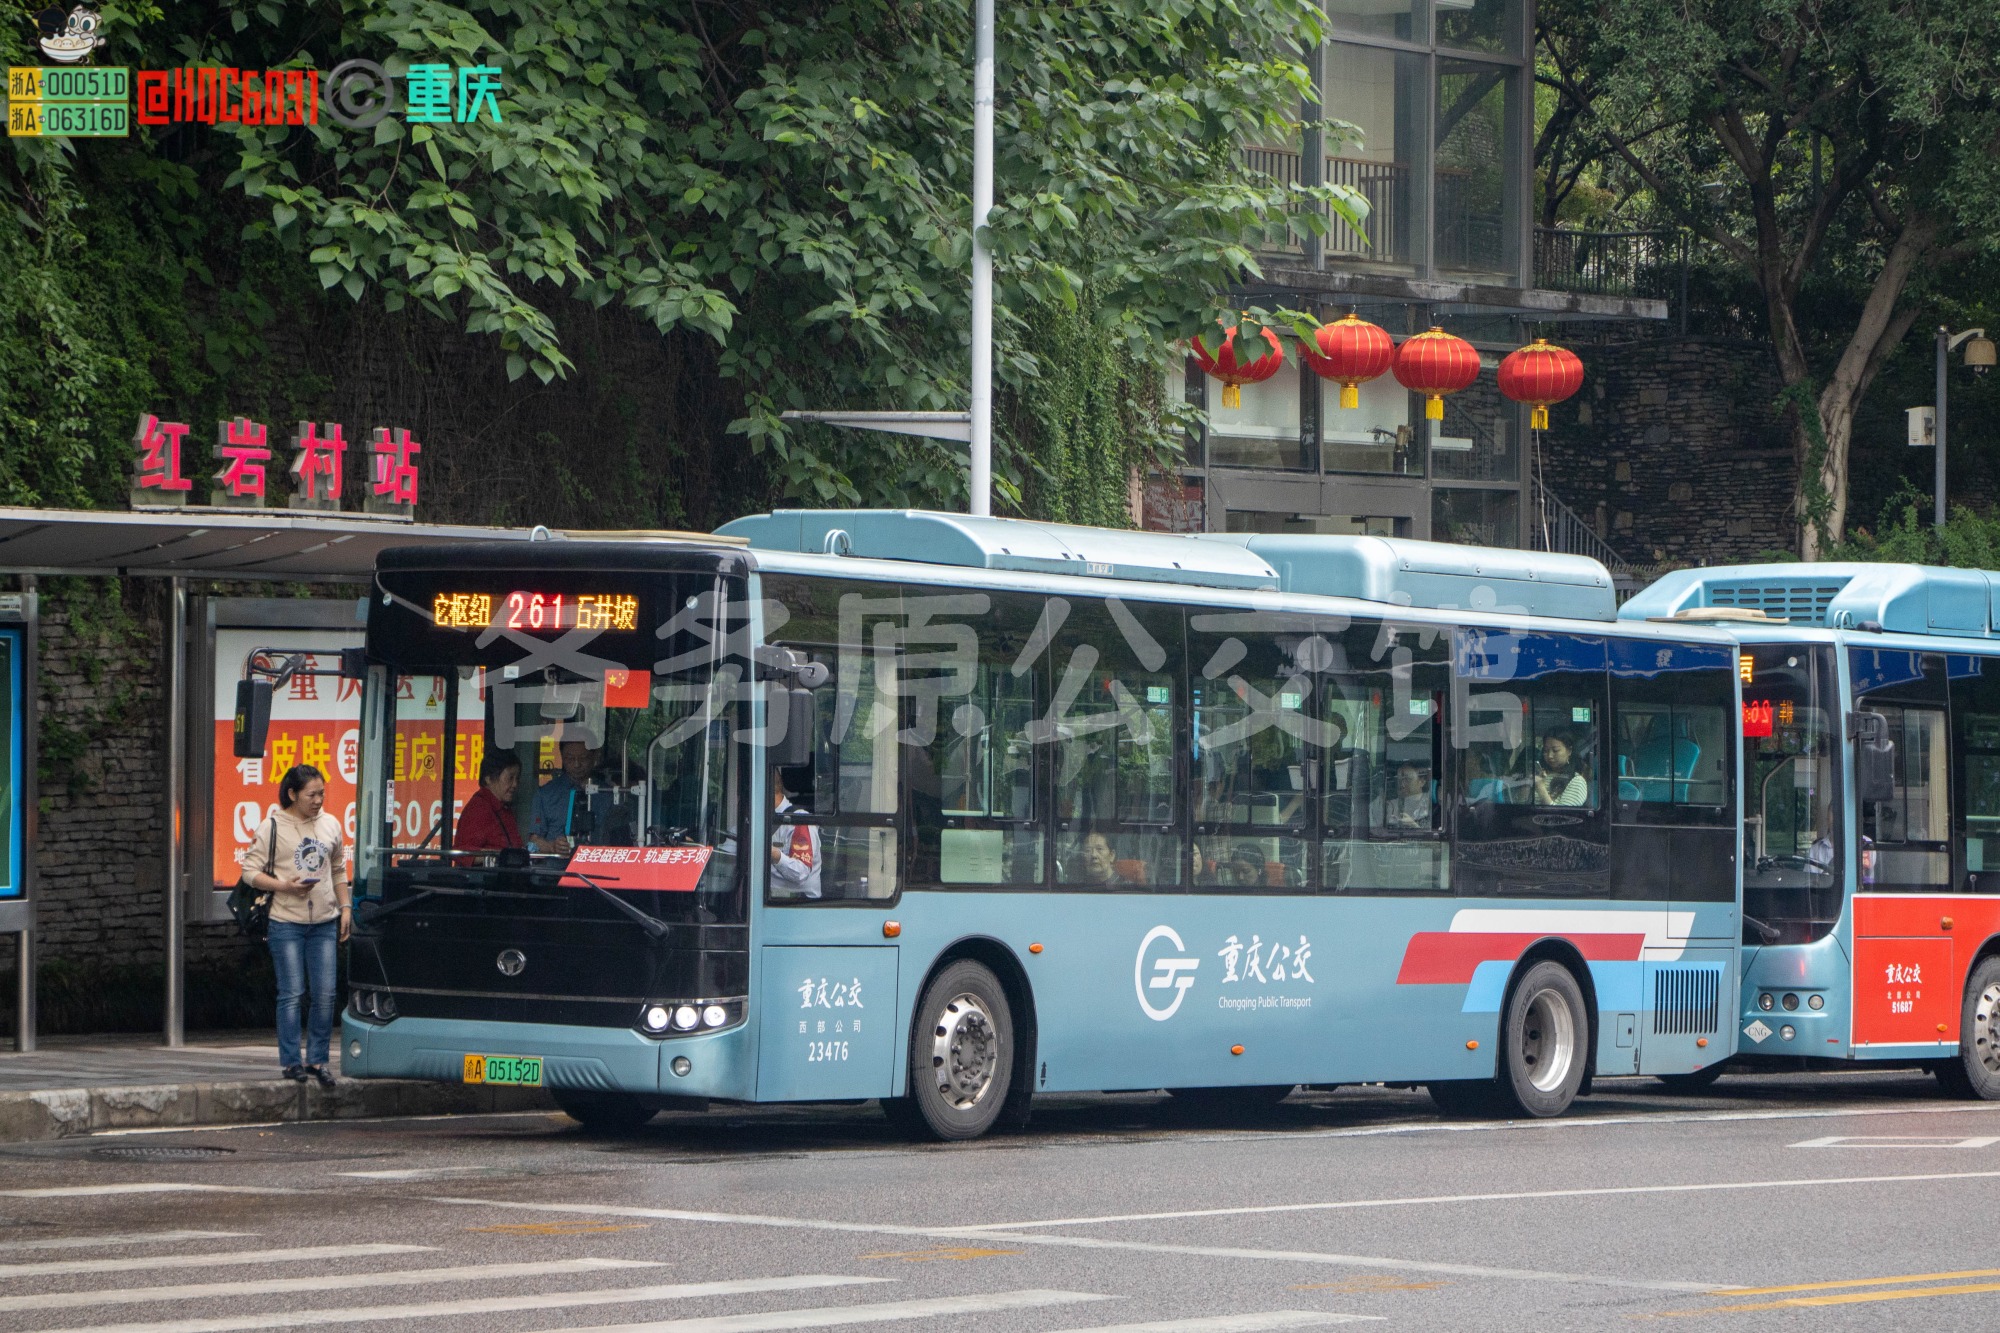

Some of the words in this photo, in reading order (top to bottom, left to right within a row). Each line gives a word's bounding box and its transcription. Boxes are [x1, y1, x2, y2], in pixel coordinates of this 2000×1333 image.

[133, 412, 421, 506] 红岩村站
[508, 593, 563, 629] 261
[576, 595, 637, 630] 石井坡
[573, 847, 710, 864] 途经磁器口、轨道李子坝
[1217, 934, 1315, 984] 重庆公交
[1885, 963, 1922, 984] 重庆公交
[797, 977, 864, 1009] 重庆公交
[1218, 996, 1257, 1011] Chongqing
[1258, 996, 1278, 1008] Public
[1280, 996, 1312, 1011] Transport
[1892, 1000, 1913, 1014] 51687
[799, 1020, 862, 1034] 西部公司
[1748, 1026, 1767, 1037] CNG
[808, 1041, 849, 1062] 23476
